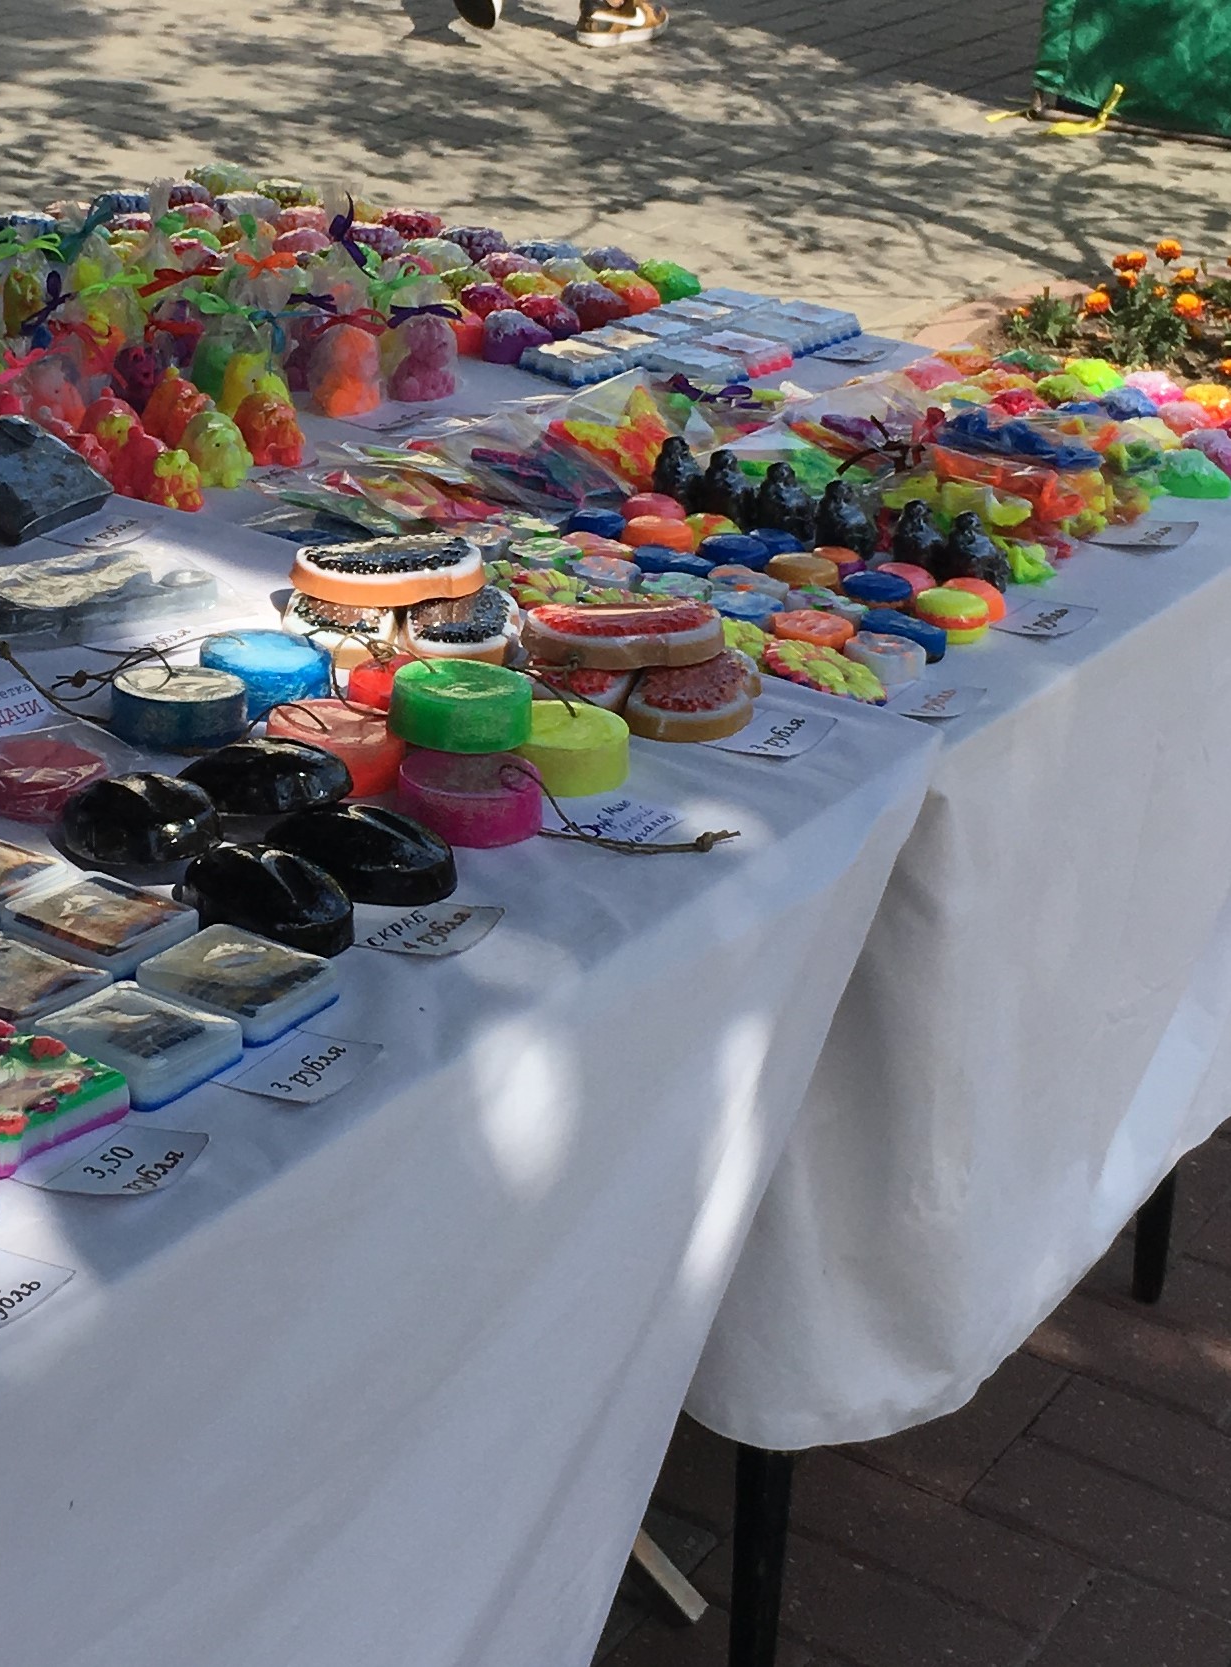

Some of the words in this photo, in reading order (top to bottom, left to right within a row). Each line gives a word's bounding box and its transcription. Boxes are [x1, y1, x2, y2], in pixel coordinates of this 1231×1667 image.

[763, 719, 805, 748] рубля
[364, 910, 428, 947] СКРАБ
[417, 911, 472, 946] рубля
[271, 1081, 292, 1092] 3
[289, 1045, 347, 1088] рубля
[83, 1146, 134, 1179] 3,50
